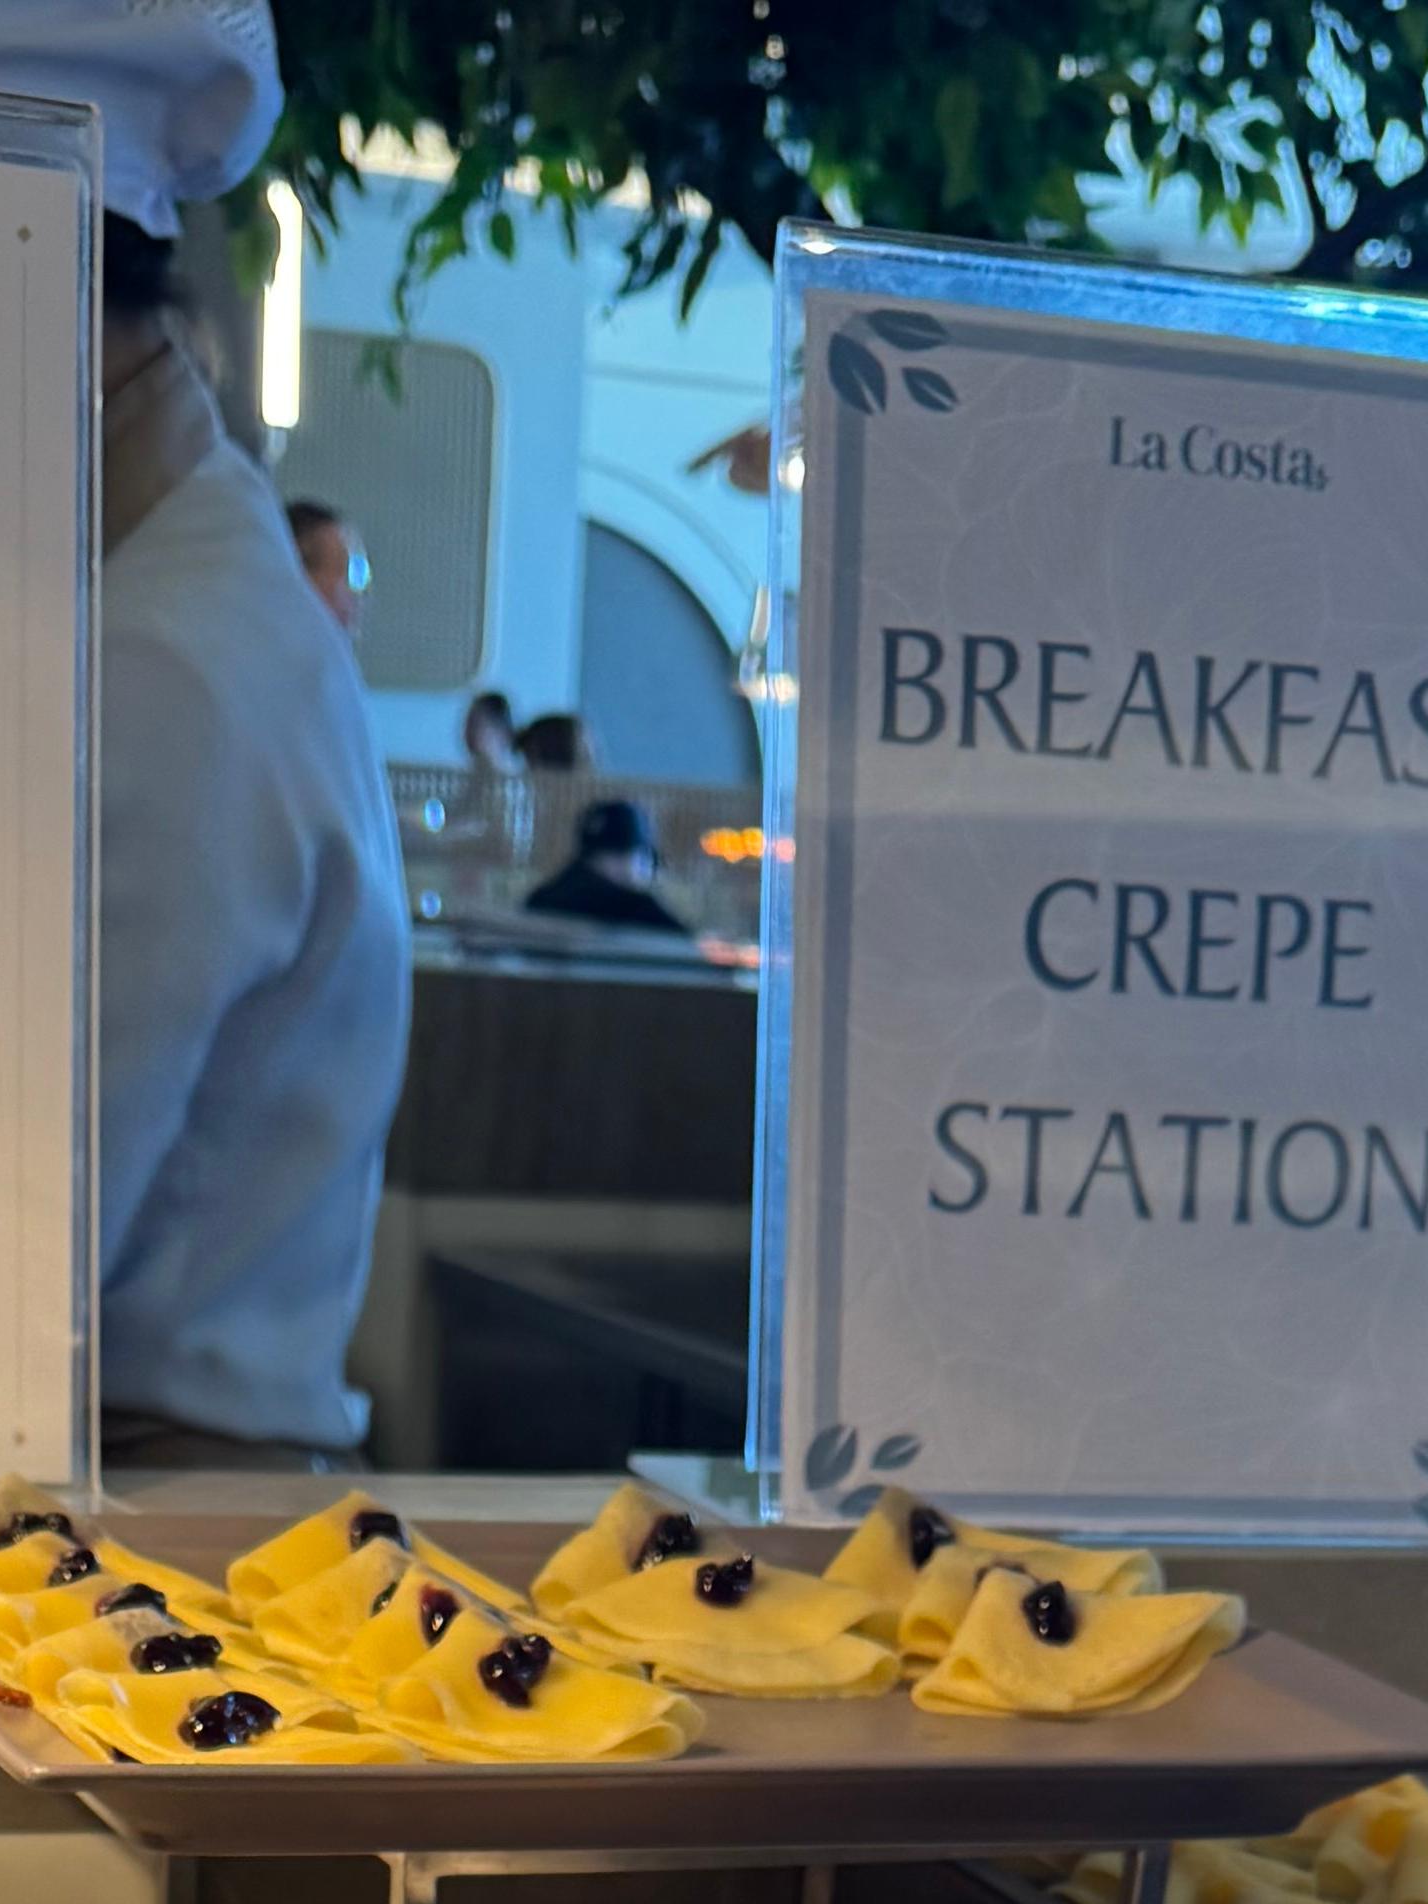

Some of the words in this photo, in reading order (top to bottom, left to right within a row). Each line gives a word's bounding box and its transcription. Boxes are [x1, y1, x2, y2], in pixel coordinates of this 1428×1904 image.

[1109, 415, 1167, 472] La
[1181, 423, 1312, 487] Costa
[1025, 877, 1376, 1009] CREPE
